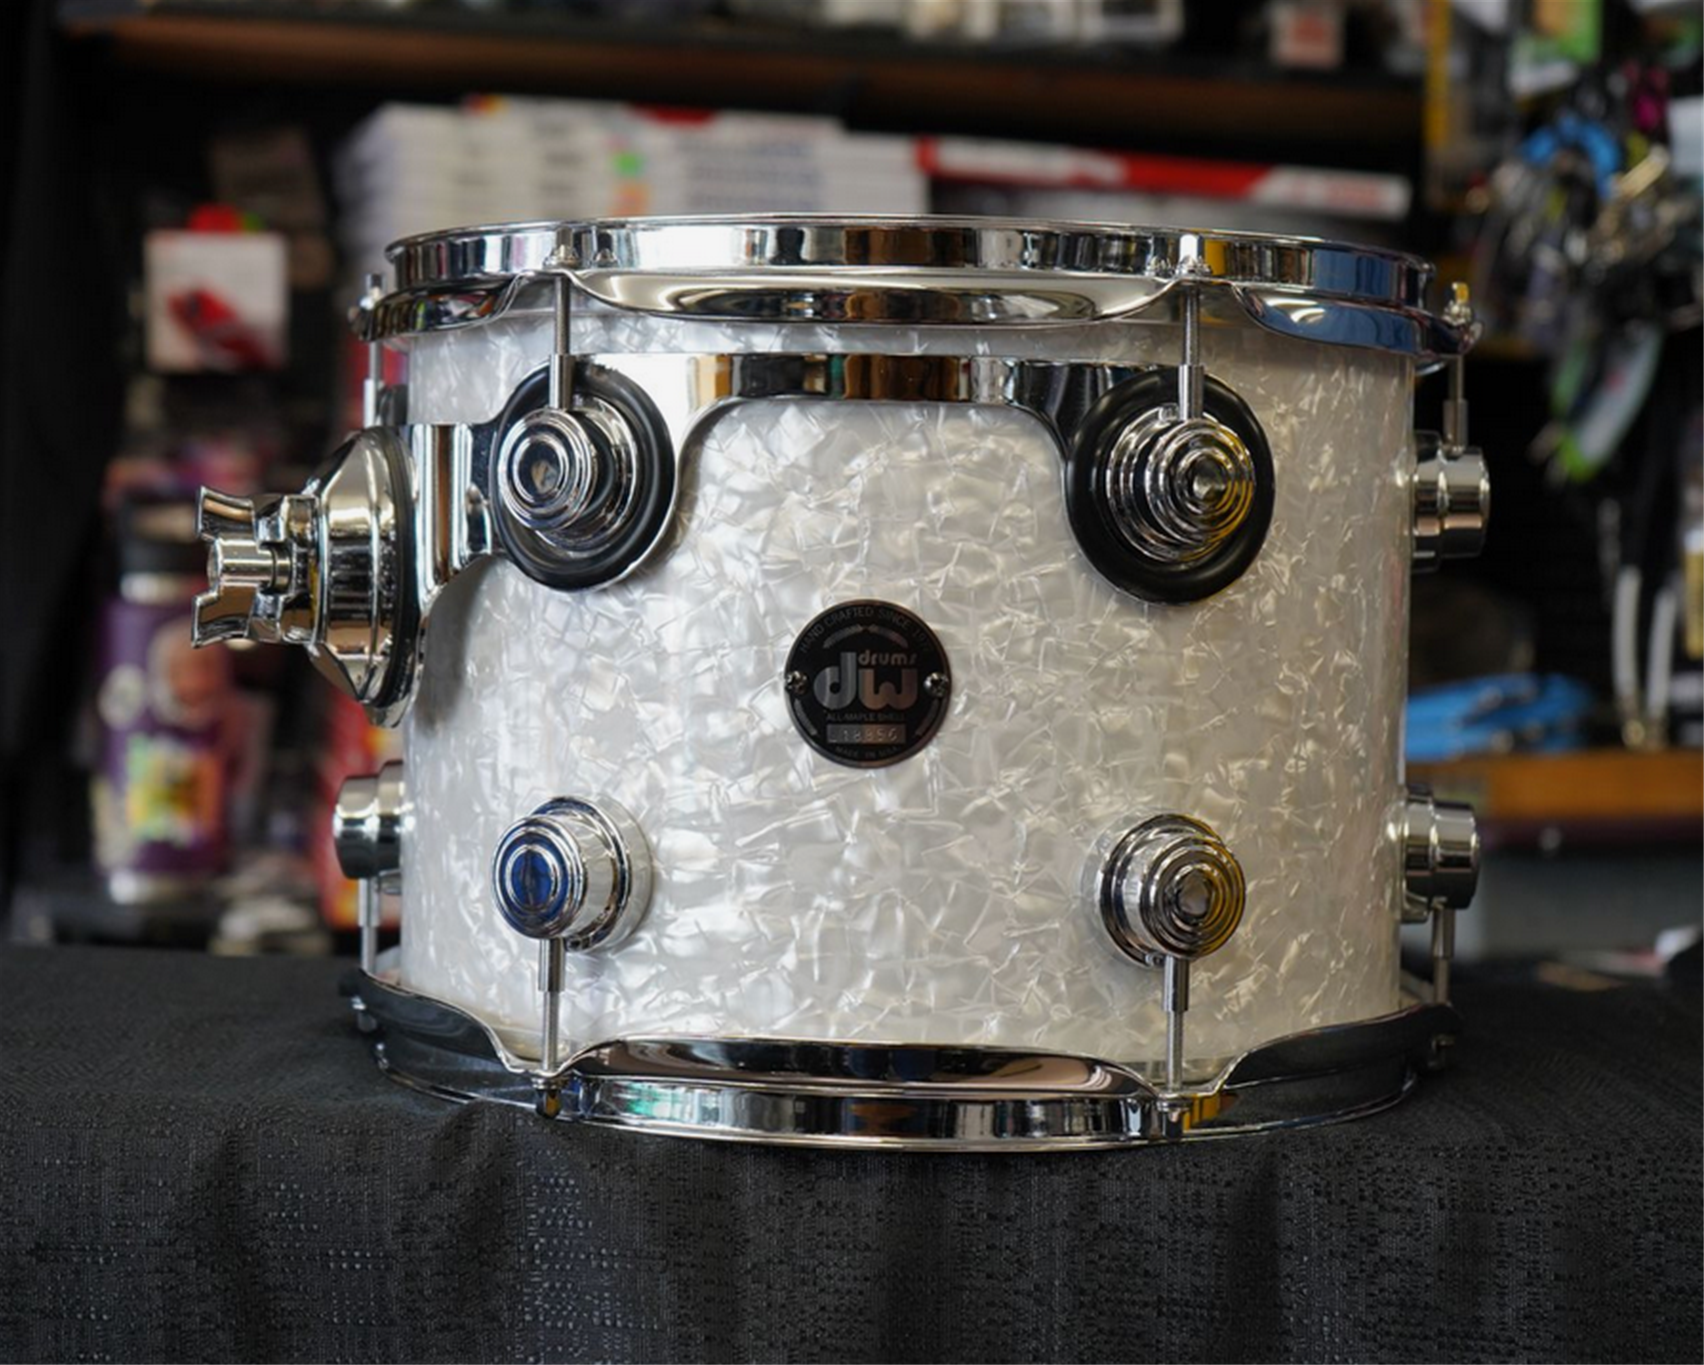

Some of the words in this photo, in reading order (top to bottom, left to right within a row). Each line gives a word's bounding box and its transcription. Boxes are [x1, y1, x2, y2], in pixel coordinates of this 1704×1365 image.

[799, 623, 825, 653] HAND
[823, 606, 875, 627] CRAFTED
[878, 608, 912, 631] SINCE
[858, 650, 918, 665] drums
